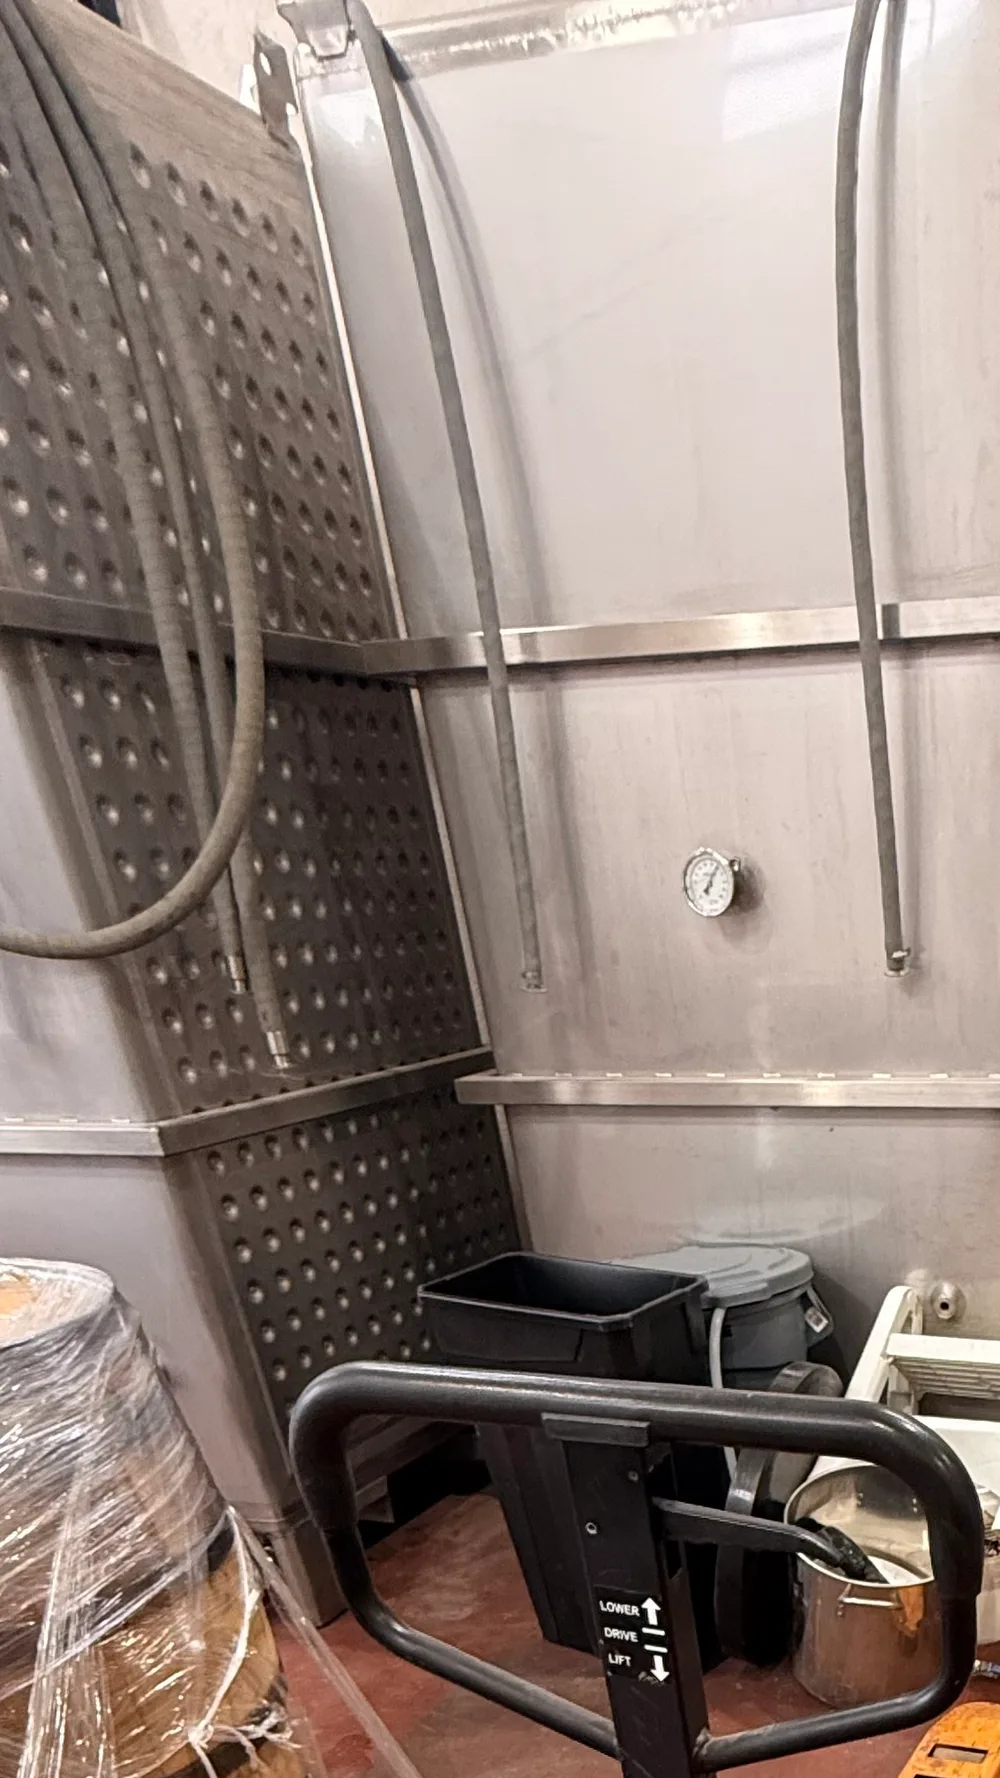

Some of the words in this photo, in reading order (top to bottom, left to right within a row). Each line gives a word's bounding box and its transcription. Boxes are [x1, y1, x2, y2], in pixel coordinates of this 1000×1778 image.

[599, 1600, 640, 1616] LOWER
[604, 1627, 638, 1642] DRIVE
[608, 1653, 631, 1666] LIFT
